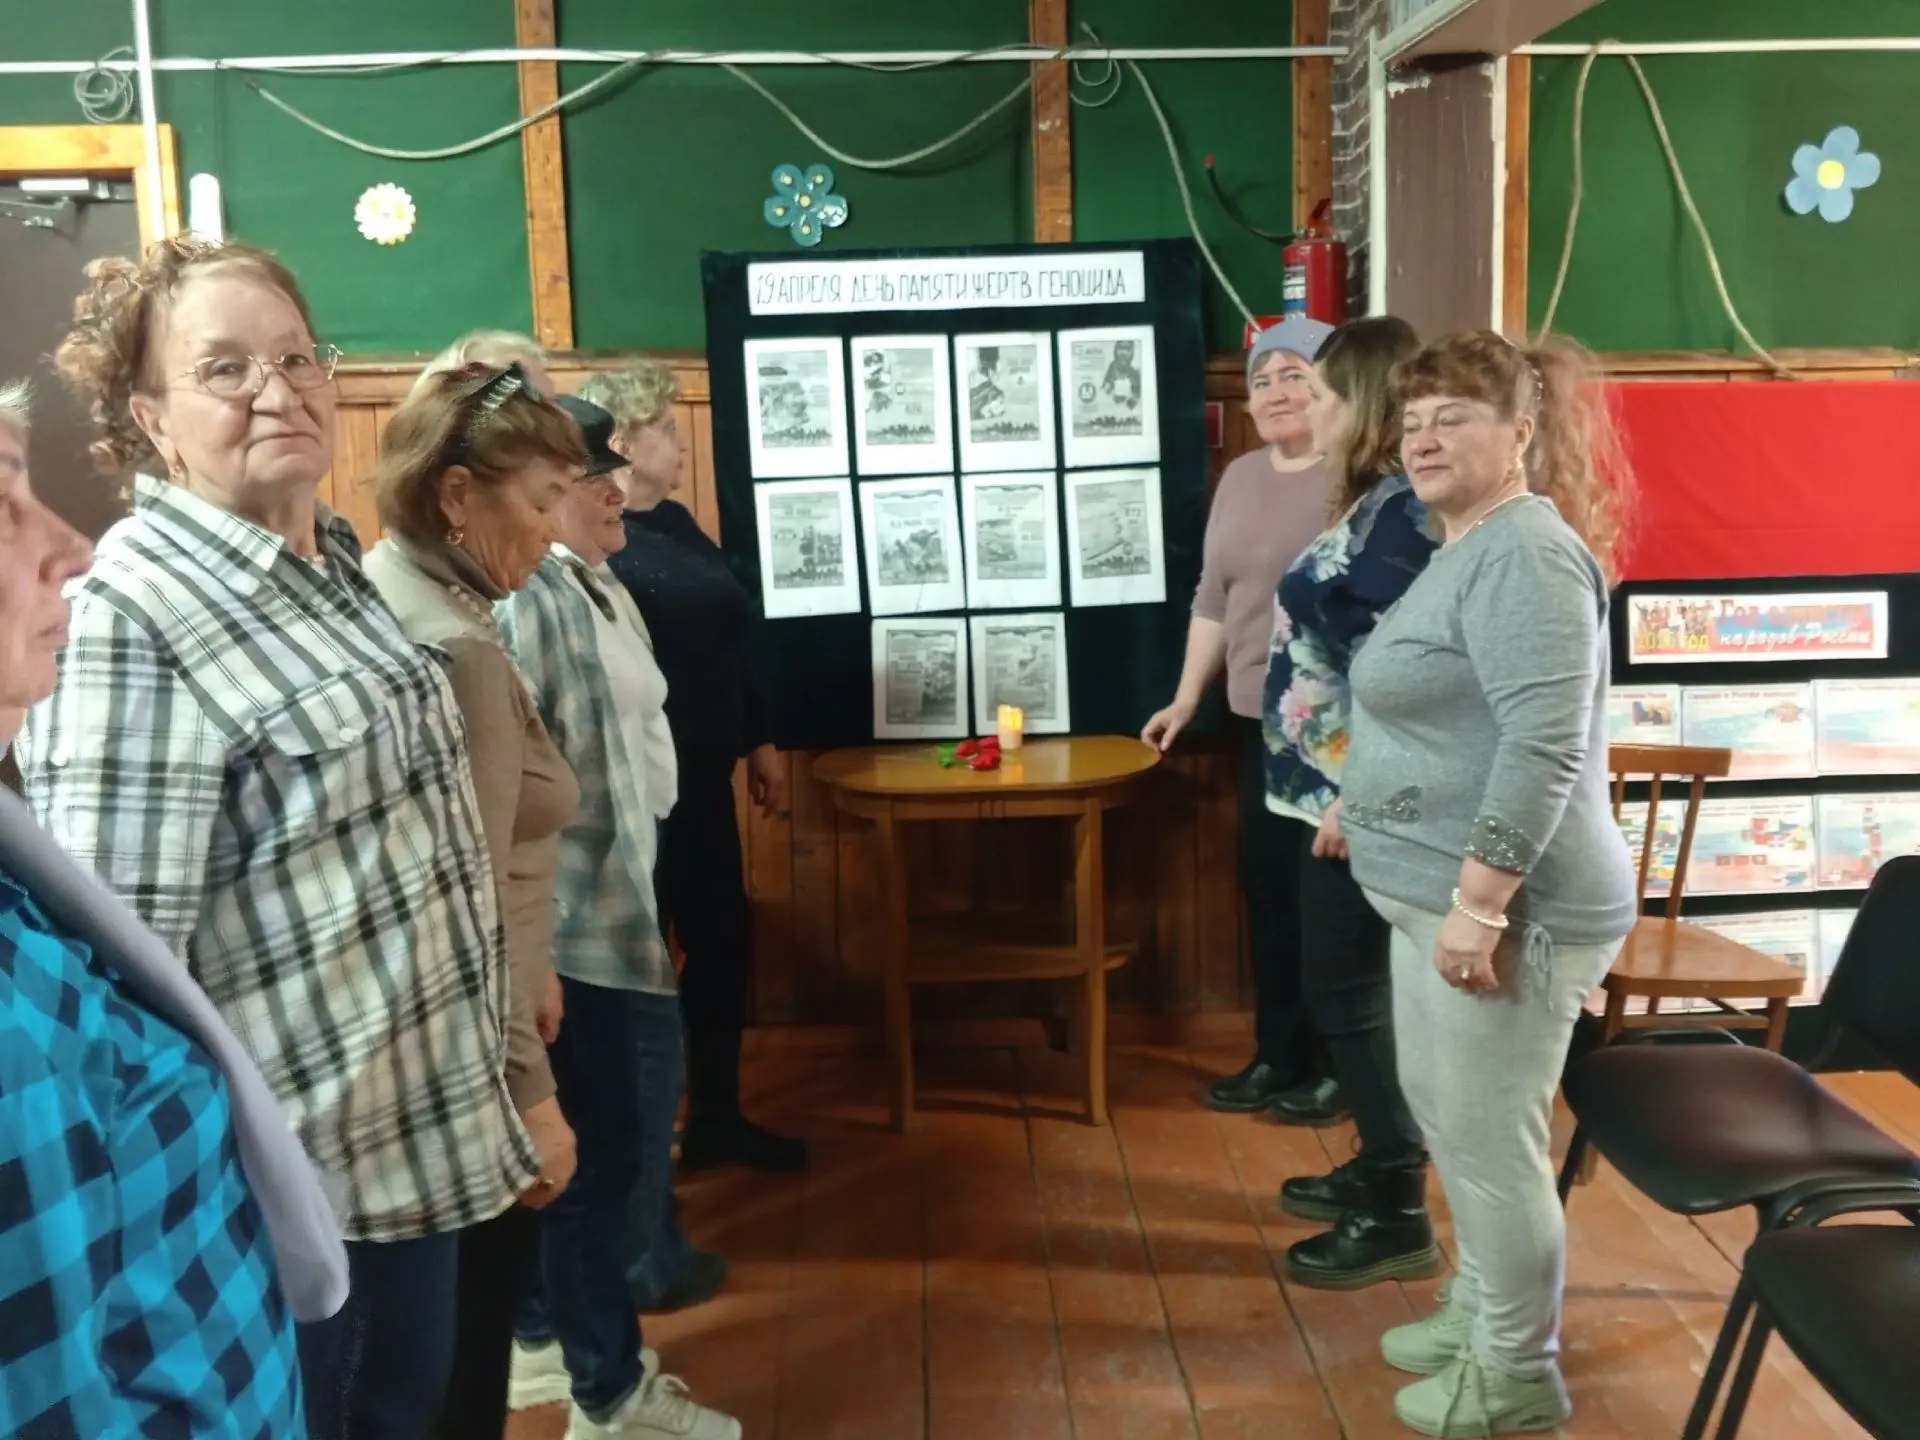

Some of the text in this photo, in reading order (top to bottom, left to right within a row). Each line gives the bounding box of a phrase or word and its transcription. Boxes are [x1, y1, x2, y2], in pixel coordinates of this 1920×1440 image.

[778, 273, 842, 305] АПРЕЛЯ
[850, 272, 895, 303] ДЕНЬ
[899, 271, 968, 302] ПАМЯТИ
[971, 269, 1032, 300] ЖЕРТВ
[1038, 266, 1127, 299] ГЕНОЦИДА
